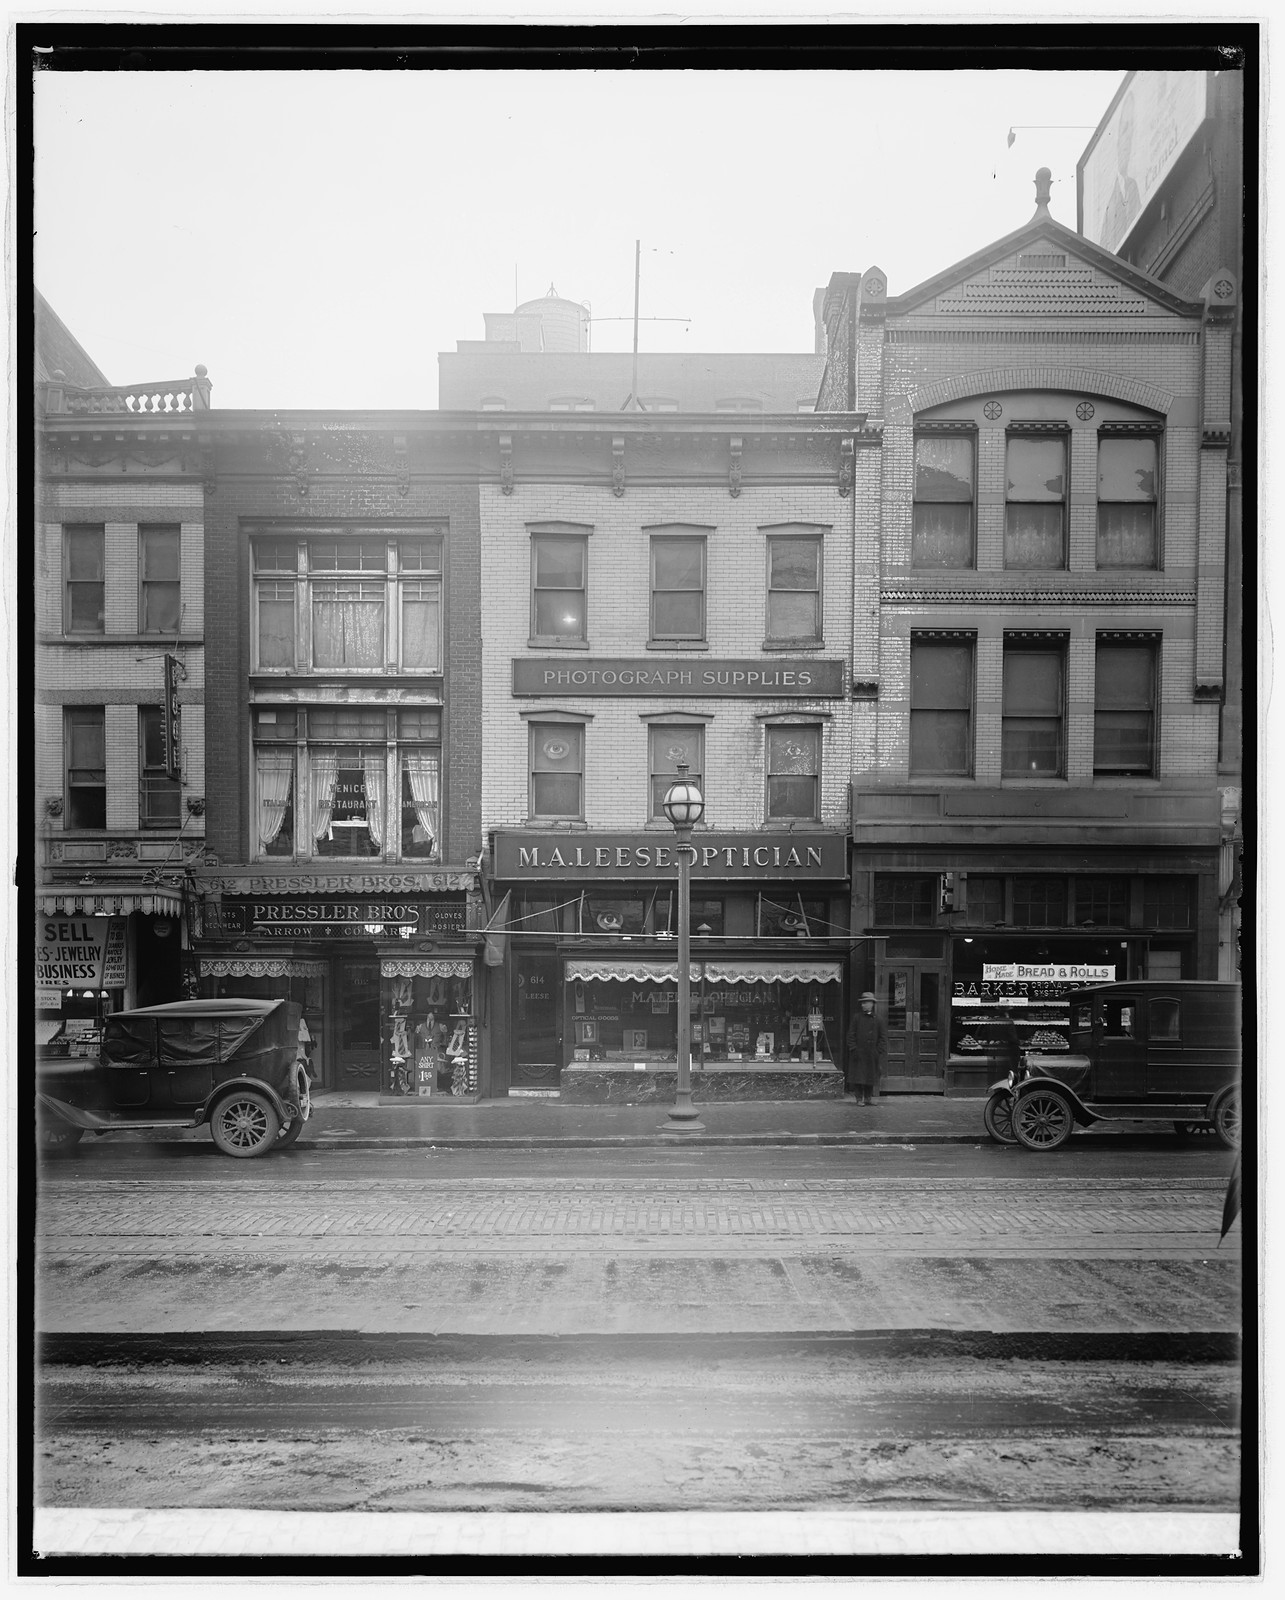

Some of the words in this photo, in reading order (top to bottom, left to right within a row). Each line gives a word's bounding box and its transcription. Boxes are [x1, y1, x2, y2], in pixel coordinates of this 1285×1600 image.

[544, 670, 693, 685] PHOTOGRAPH
[702, 671, 813, 686] SUPPLIES
[330, 783, 367, 794] VENICE
[318, 799, 378, 810] RESTAURANT
[250, 877, 354, 890] PRESSLER
[433, 876, 459, 887] 612
[208, 911, 237, 919] SHRTS
[253, 904, 360, 921] PRESSLER
[434, 912, 463, 920] GLOVES
[44, 923, 95, 942] SELL
[264, 927, 313, 936] ARROW
[432, 923, 466, 931] HOSIERY
[37, 964, 96, 979] BUSINESS
[1018, 966, 1056, 979] BREAD
[1059, 967, 1068, 979] &
[1070, 966, 1110, 979] ROLLS
[529, 975, 546, 984] 614
[953, 982, 1030, 996] BARKER
[525, 992, 552, 1000] LEESE
